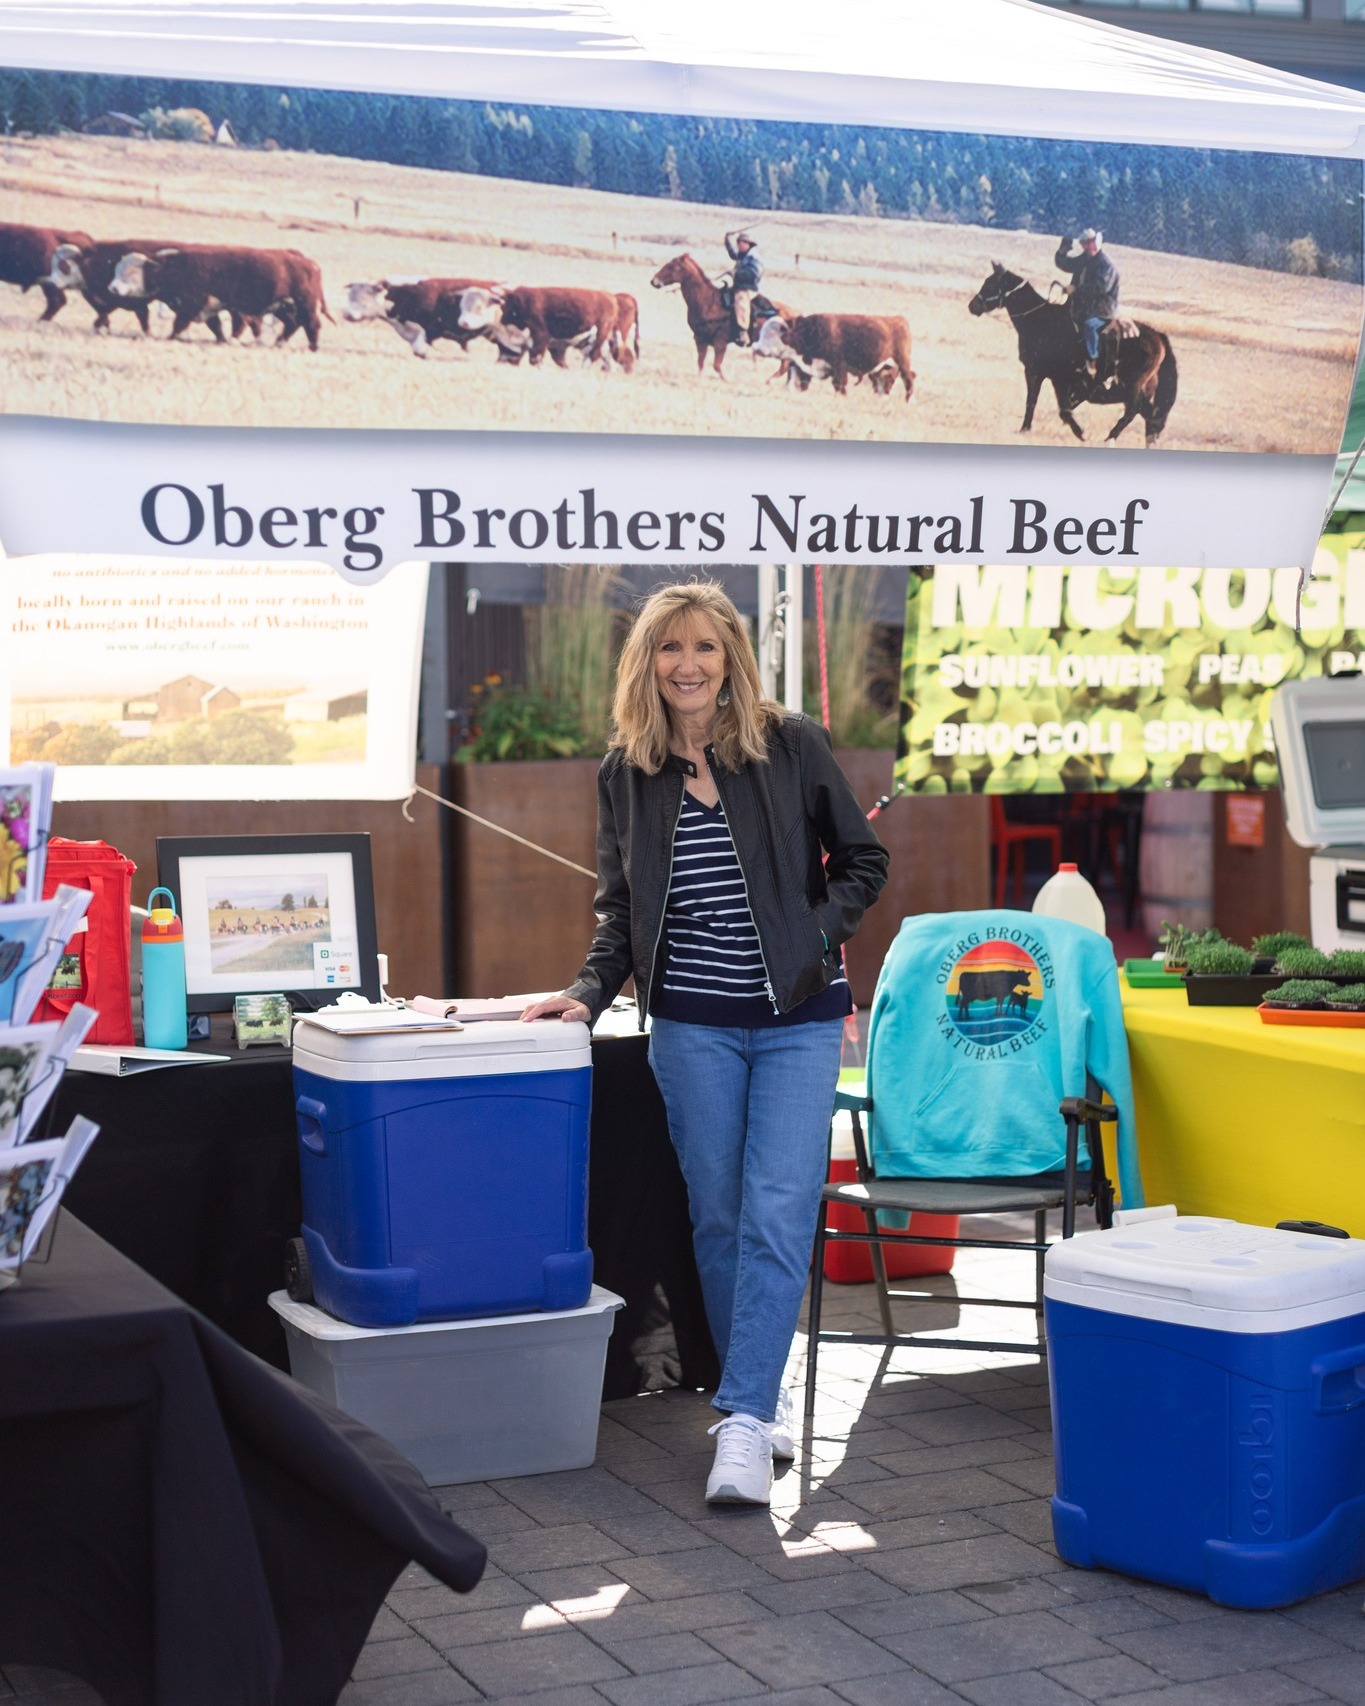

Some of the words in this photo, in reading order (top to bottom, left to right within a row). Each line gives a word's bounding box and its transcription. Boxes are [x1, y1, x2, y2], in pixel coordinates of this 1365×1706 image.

[140, 483, 385, 571] Oberg
[411, 487, 725, 551] Brothers
[749, 494, 984, 554] Natural
[1006, 498, 1150, 556] Beef
[75, 565, 157, 577] antibiotics
[161, 565, 190, 577] and
[18, 595, 72, 610] locally
[80, 593, 122, 606] born
[130, 593, 161, 606] and
[168, 593, 221, 606] raised
[228, 598, 249, 606] on
[256, 598, 284, 606] our
[292, 592, 341, 606] ranch
[348, 593, 364, 606] in
[12, 619, 37, 632] the
[47, 616, 138, 632] Okanogan
[146, 614, 235, 631] Highlands
[242, 615, 260, 628] of
[267, 615, 369, 631] Washington
[938, 653, 1164, 689] SUNFLOWER
[1199, 653, 1284, 686] PEAS
[933, 721, 1122, 757] BROCCOLI
[1144, 718, 1254, 753] SPICY
[936, 932, 980, 984] OBERG
[986, 926, 1056, 989] BROTHERS
[936, 1013, 1008, 1061] NATURAL
[1009, 1018, 1048, 1053] BEEF
[1239, 1394, 1273, 1535] igloo
